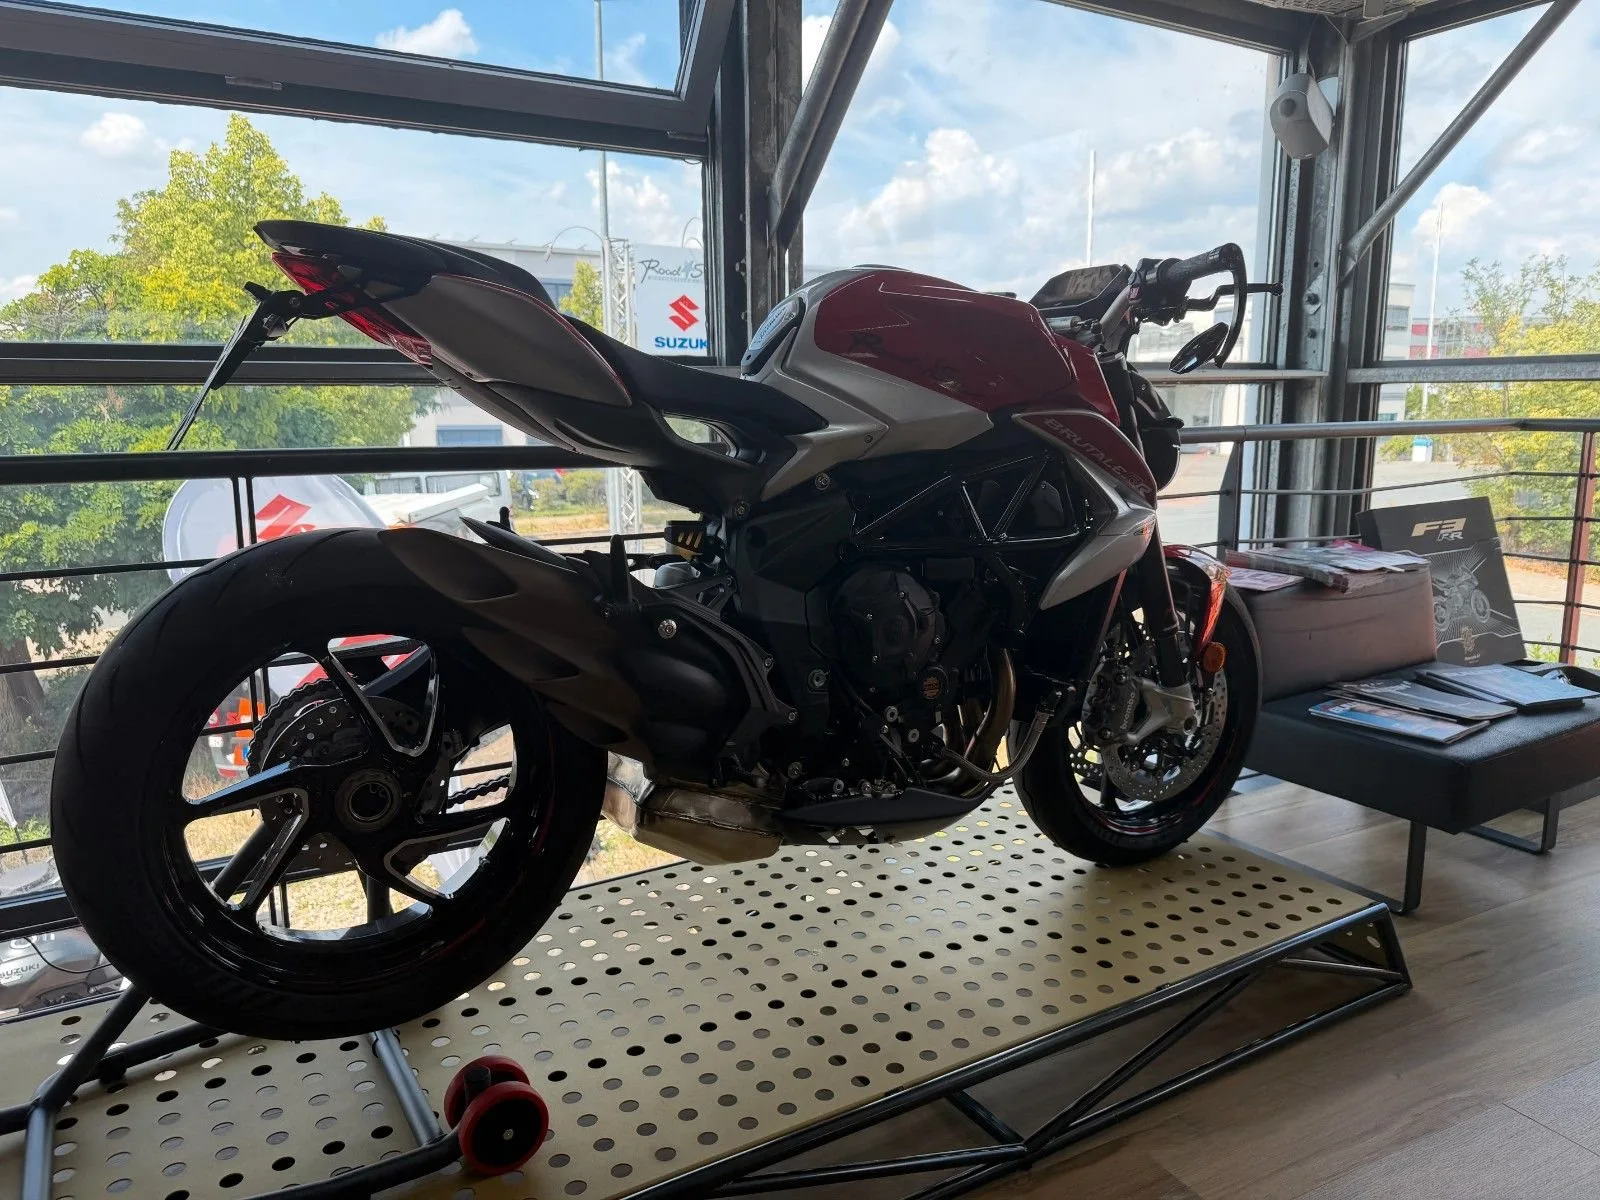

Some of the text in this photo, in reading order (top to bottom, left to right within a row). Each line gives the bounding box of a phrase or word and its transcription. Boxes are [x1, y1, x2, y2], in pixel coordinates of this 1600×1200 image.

[638, 258, 682, 284] Road
[1043, 417, 1128, 474] BRUTALE
[1411, 517, 1467, 537] F3
[1120, 692, 1136, 730] brembo
[0, 963, 40, 979] SUZUKI
